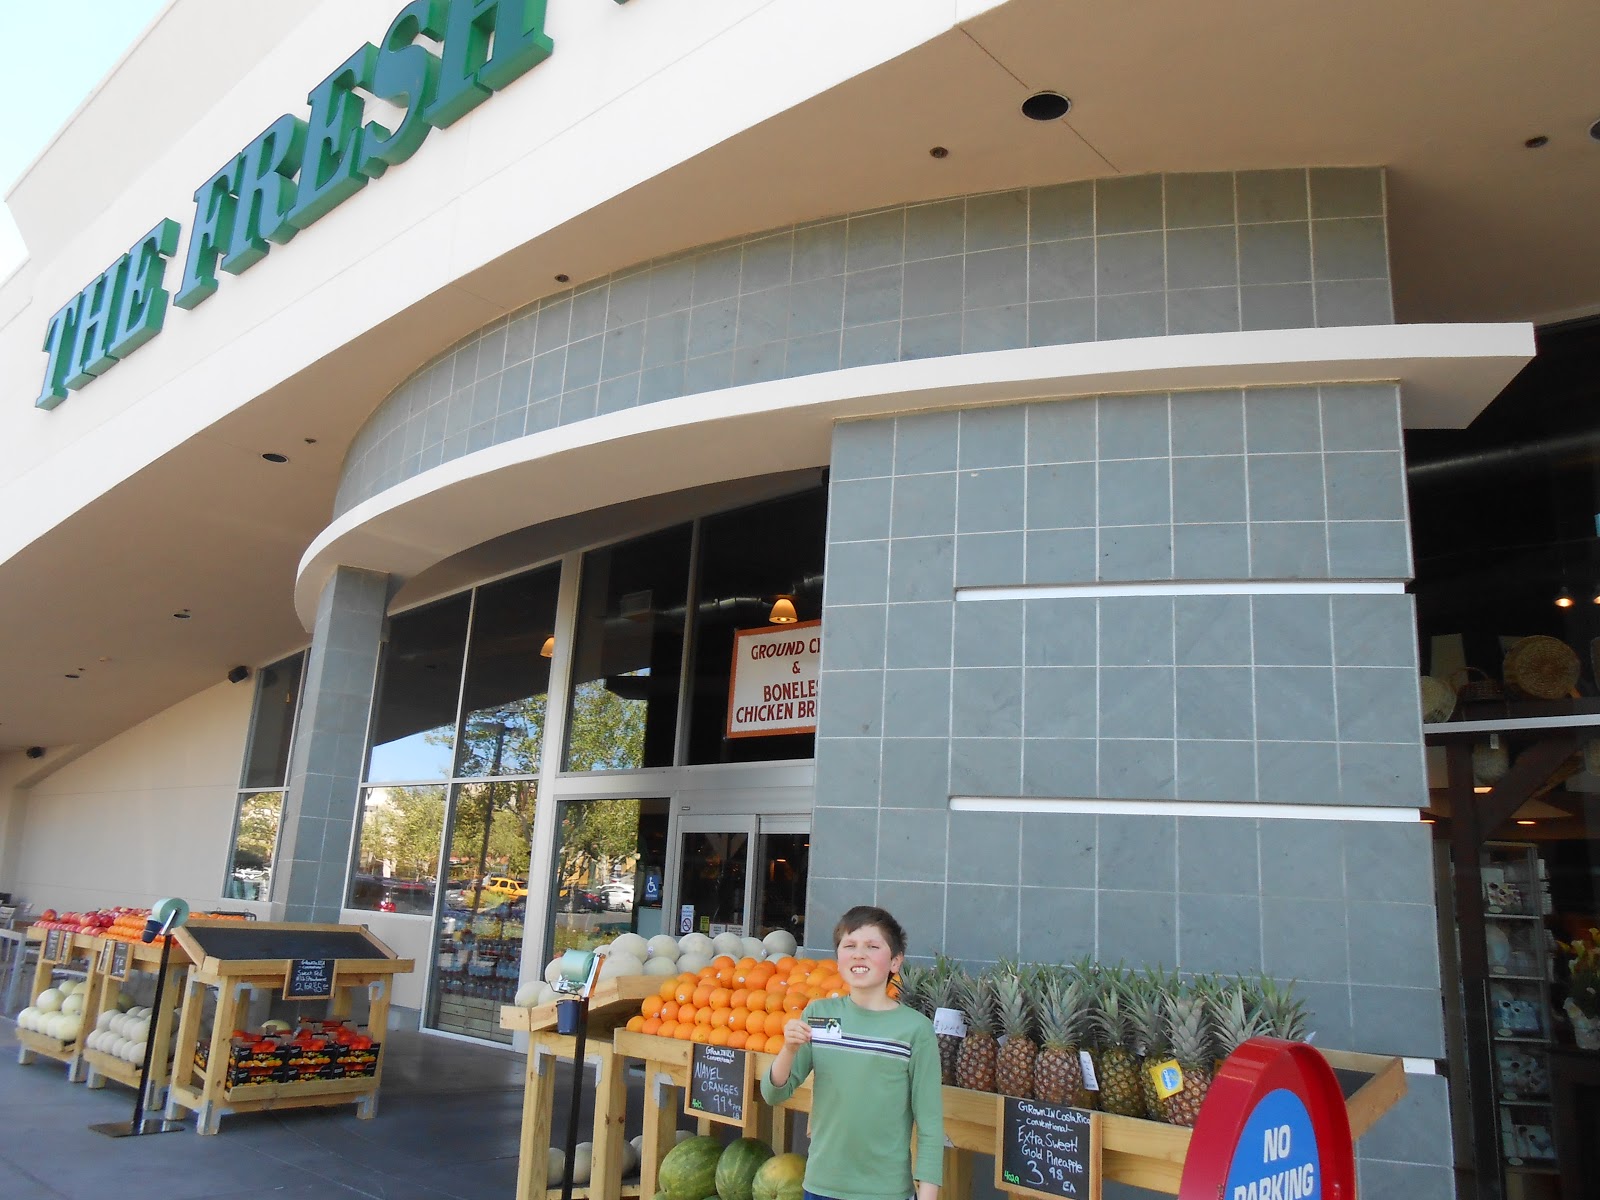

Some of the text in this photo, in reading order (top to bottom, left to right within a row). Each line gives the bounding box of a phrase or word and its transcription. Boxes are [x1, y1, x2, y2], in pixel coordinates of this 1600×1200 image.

[35, 0, 554, 411] THE FRESH
[751, 640, 805, 660] GROUND
[792, 661, 800, 674] &
[736, 702, 793, 723] CHICKEN
[694, 1061, 724, 1080] NAVEL
[701, 1080, 739, 1096] ORANGES
[1018, 1125, 1078, 1153] Extra Sweet!
[1263, 1124, 1291, 1163] NO
[1021, 1144, 1083, 1174] Gold Pineapple
